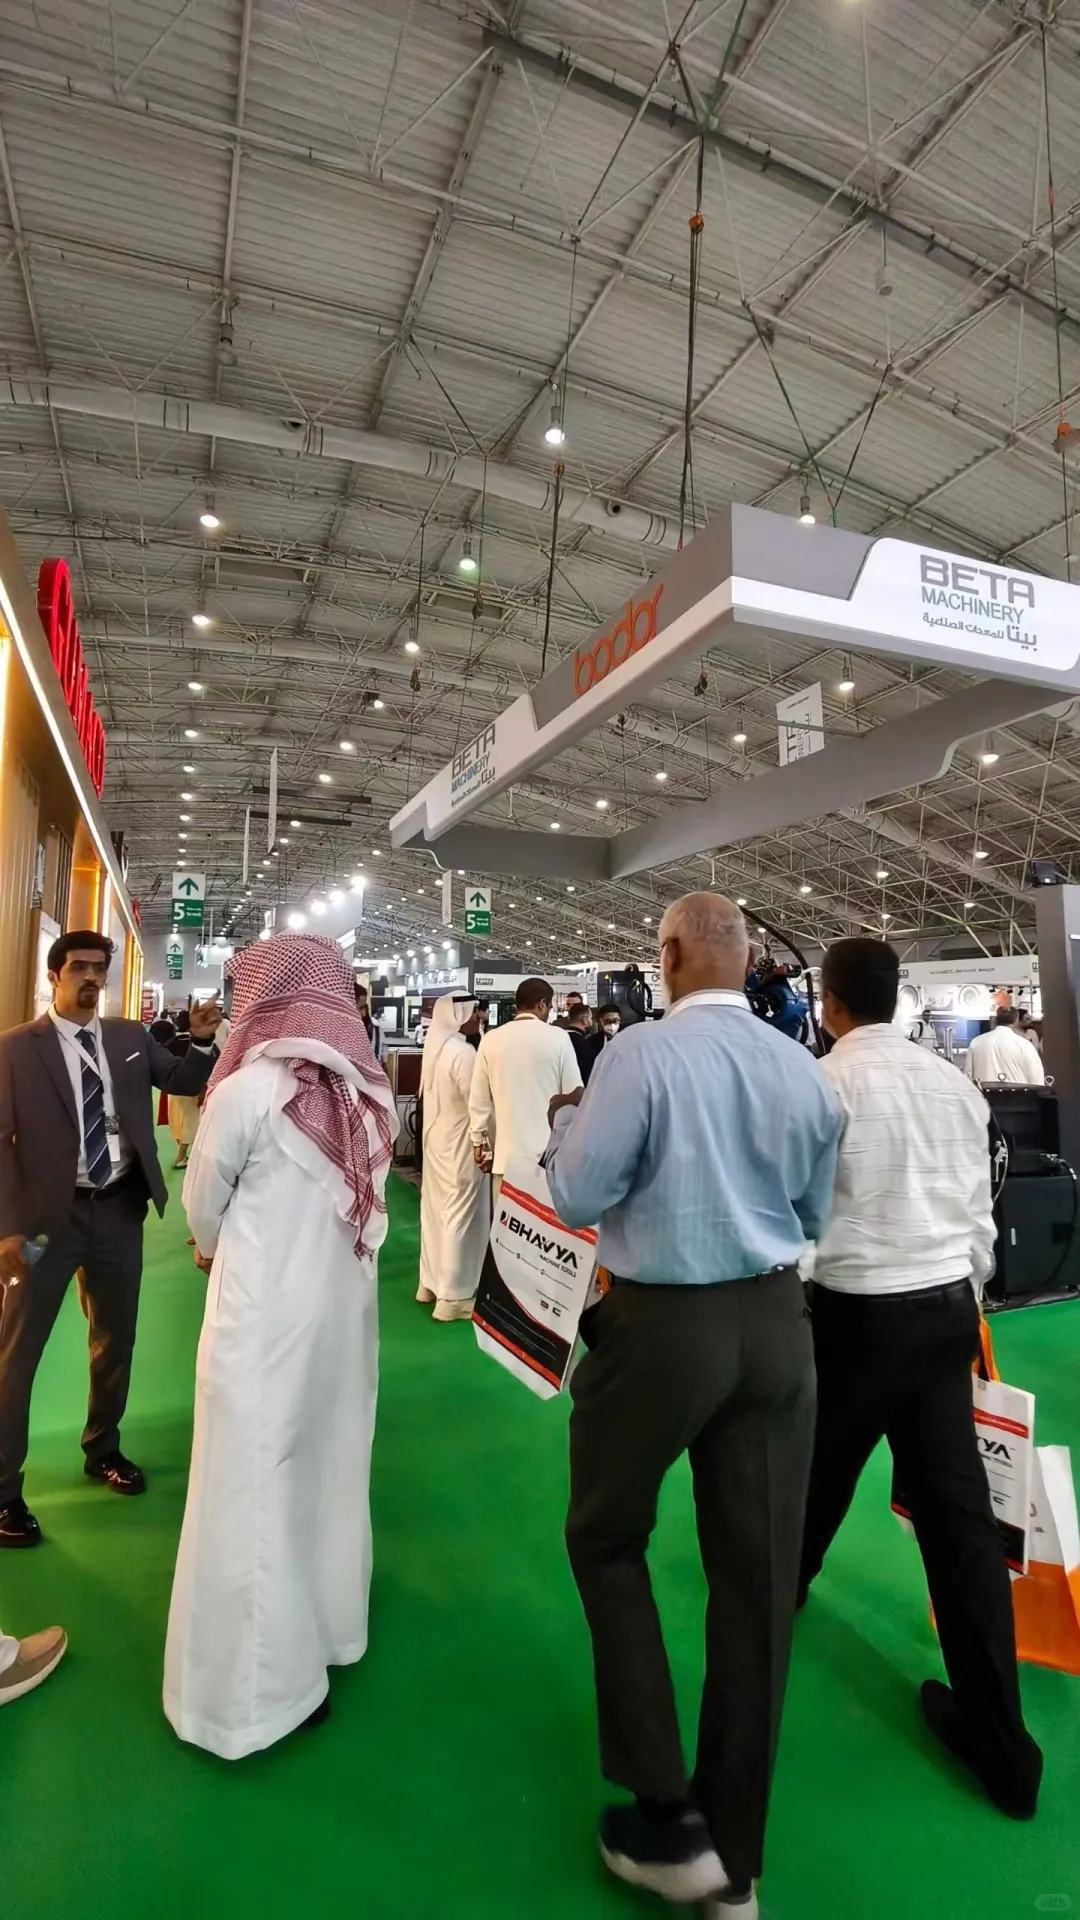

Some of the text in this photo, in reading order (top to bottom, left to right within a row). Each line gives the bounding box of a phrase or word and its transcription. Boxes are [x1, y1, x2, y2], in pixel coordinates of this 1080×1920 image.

[920, 554, 1035, 608] BETA
[921, 586, 1024, 624] MACHINERY
[922, 611, 964, 631] الصناعية
[1007, 624, 1038, 652] بيتا
[452, 722, 496, 780] BETA
[451, 751, 490, 794] MACHINERY
[173, 902, 186, 921] 5
[466, 913, 476, 930] 5
[167, 955, 174, 966] 5
[170, 970, 176, 979] 5
[508, 1216, 578, 1269] BHAVYA
[978, 1437, 1011, 1460] YA
